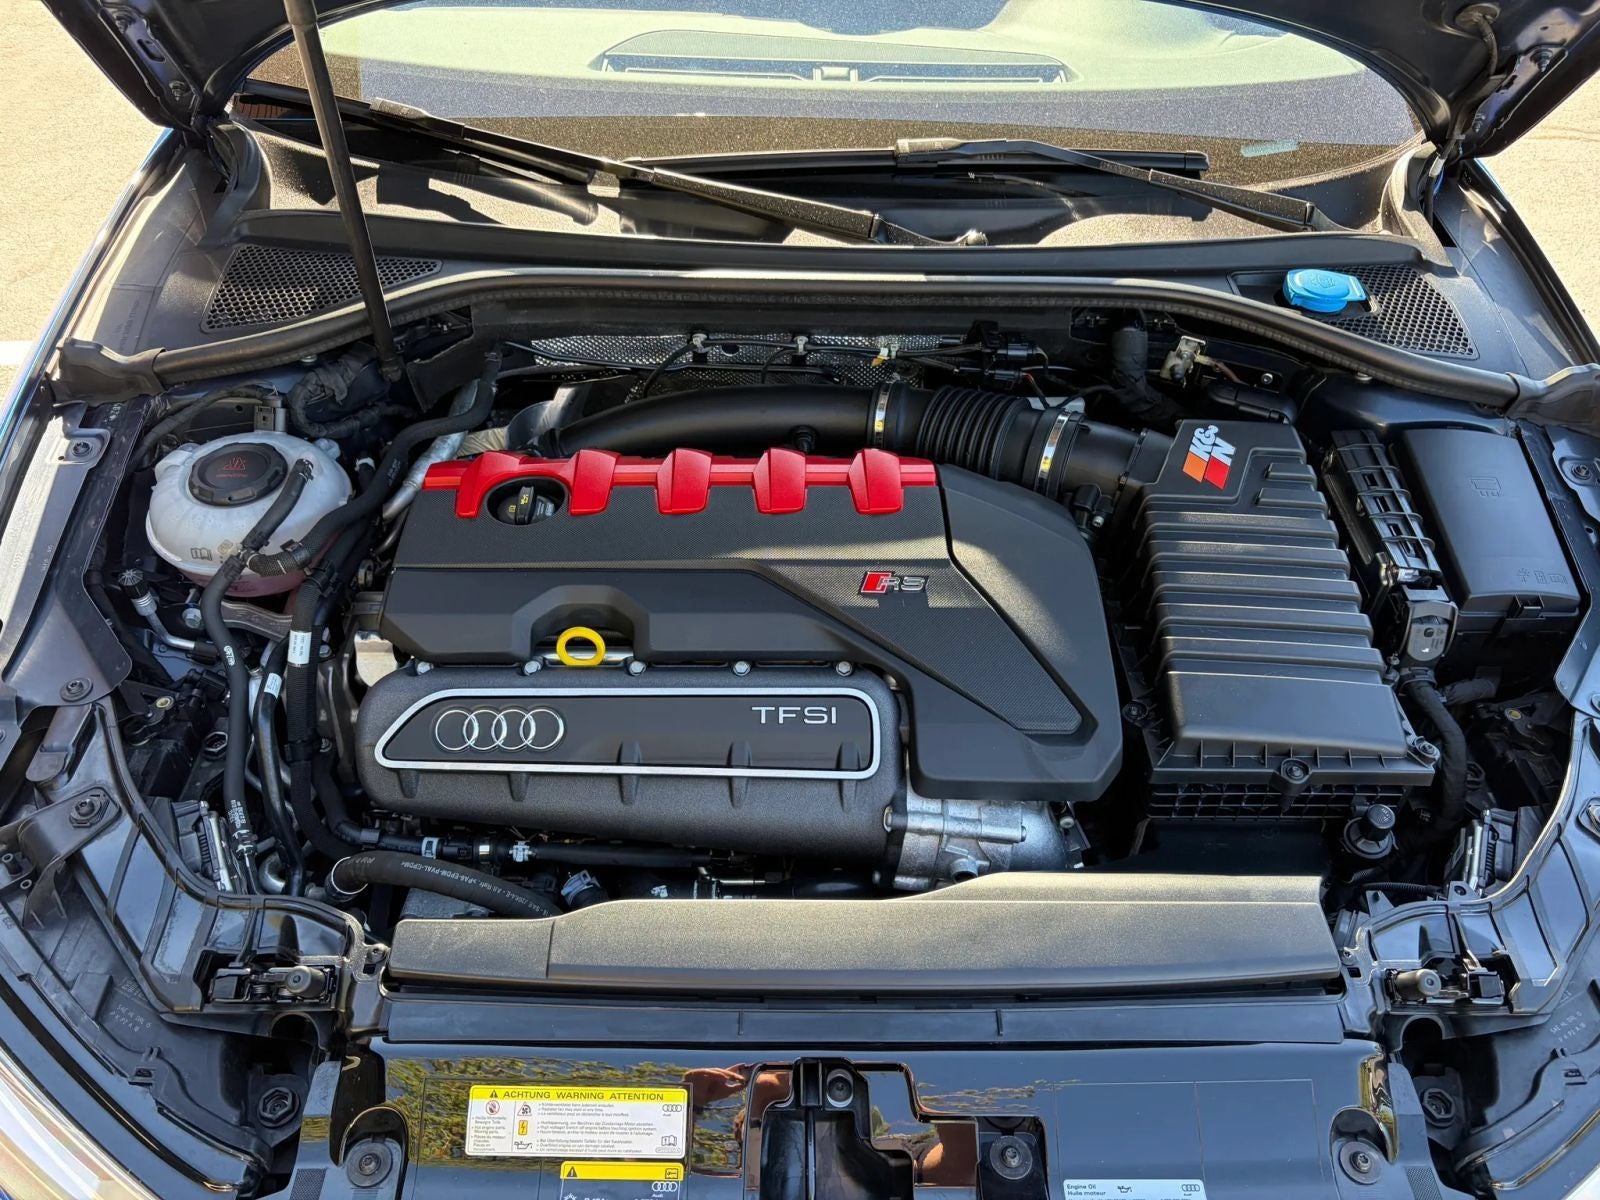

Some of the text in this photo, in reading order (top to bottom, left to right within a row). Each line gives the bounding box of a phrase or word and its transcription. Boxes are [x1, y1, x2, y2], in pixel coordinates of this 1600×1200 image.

[1189, 424, 1236, 467] K&N
[864, 572, 926, 593] RS
[752, 706, 837, 724] TFSI
[503, 1091, 664, 1101] ACHTUNG WARNING ATTENTION
